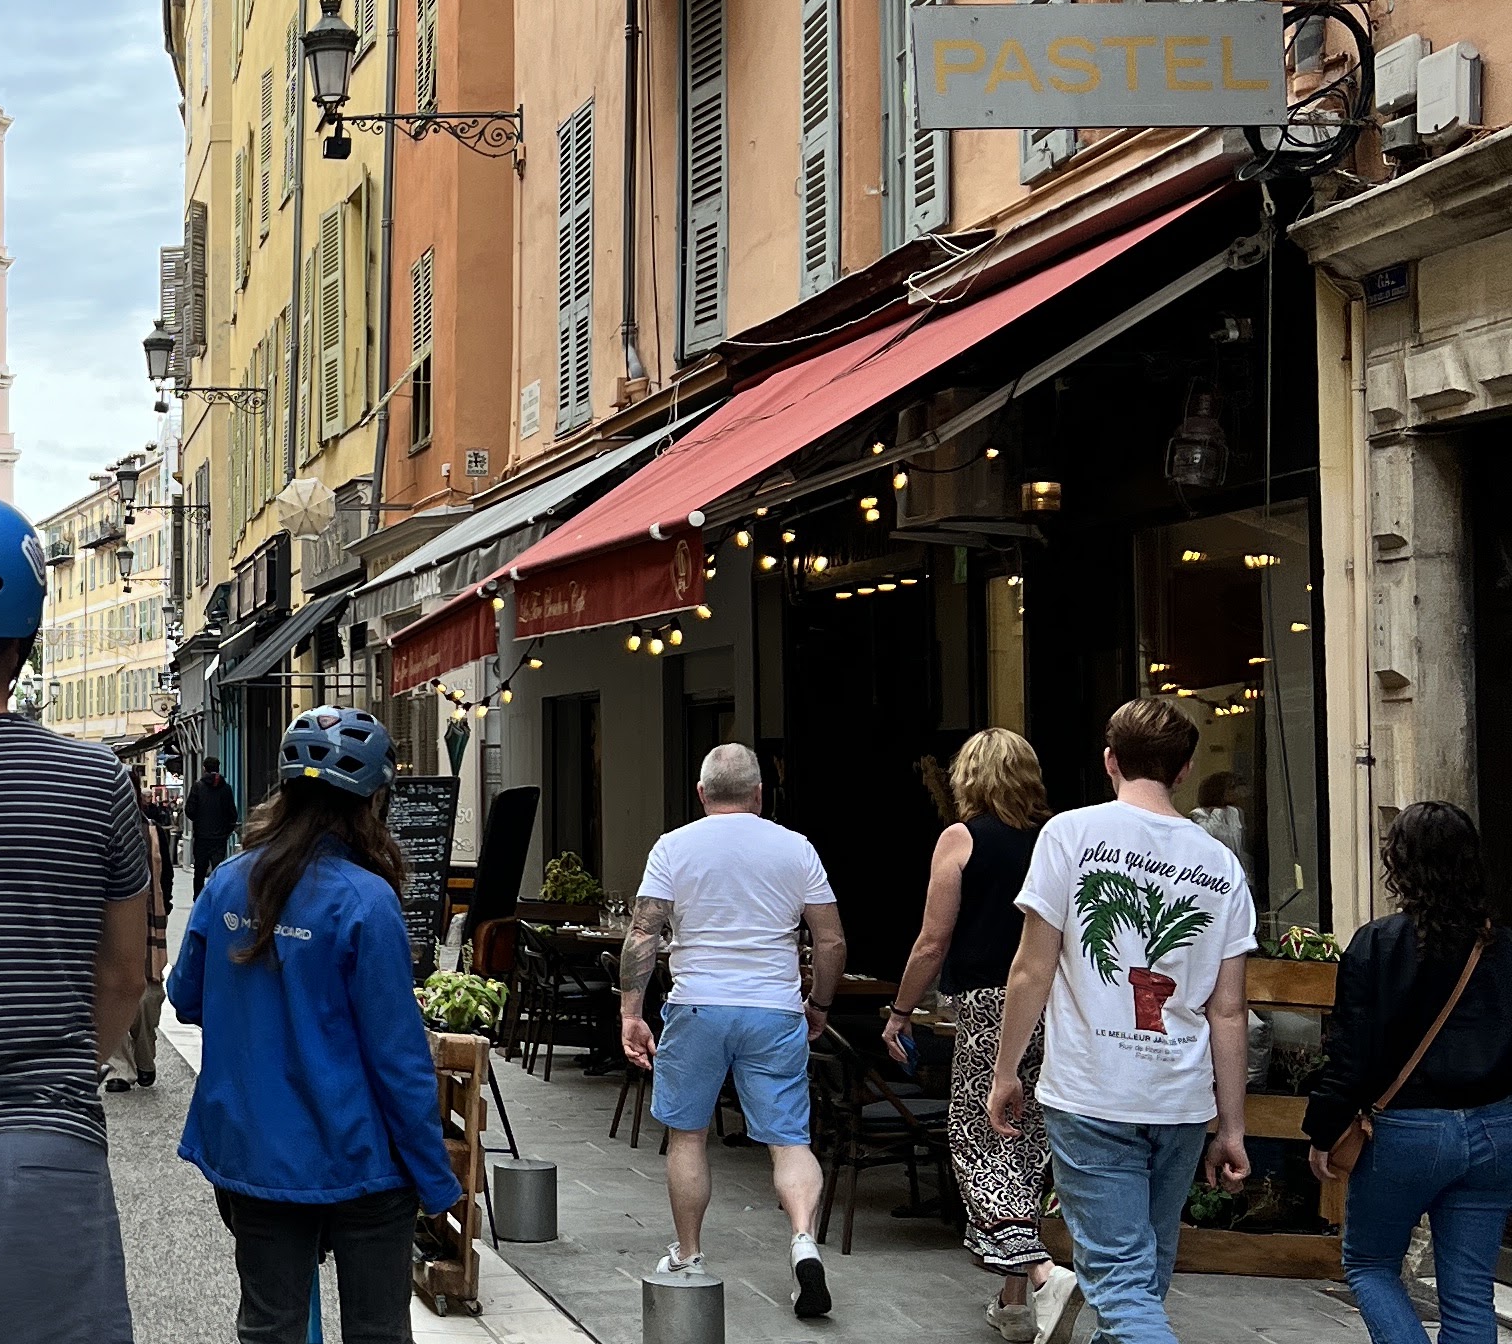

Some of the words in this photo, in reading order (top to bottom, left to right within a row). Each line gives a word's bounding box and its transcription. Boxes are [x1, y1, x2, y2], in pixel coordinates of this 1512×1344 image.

[933, 35, 1271, 95] PASTEL
[1079, 840, 1121, 868] plus
[1125, 851, 1178, 878] qu'une
[1173, 865, 1232, 895] plante
[240, 918, 312, 941] MOBOARD
[1108, 1030, 1151, 1042] MEILLEUR
